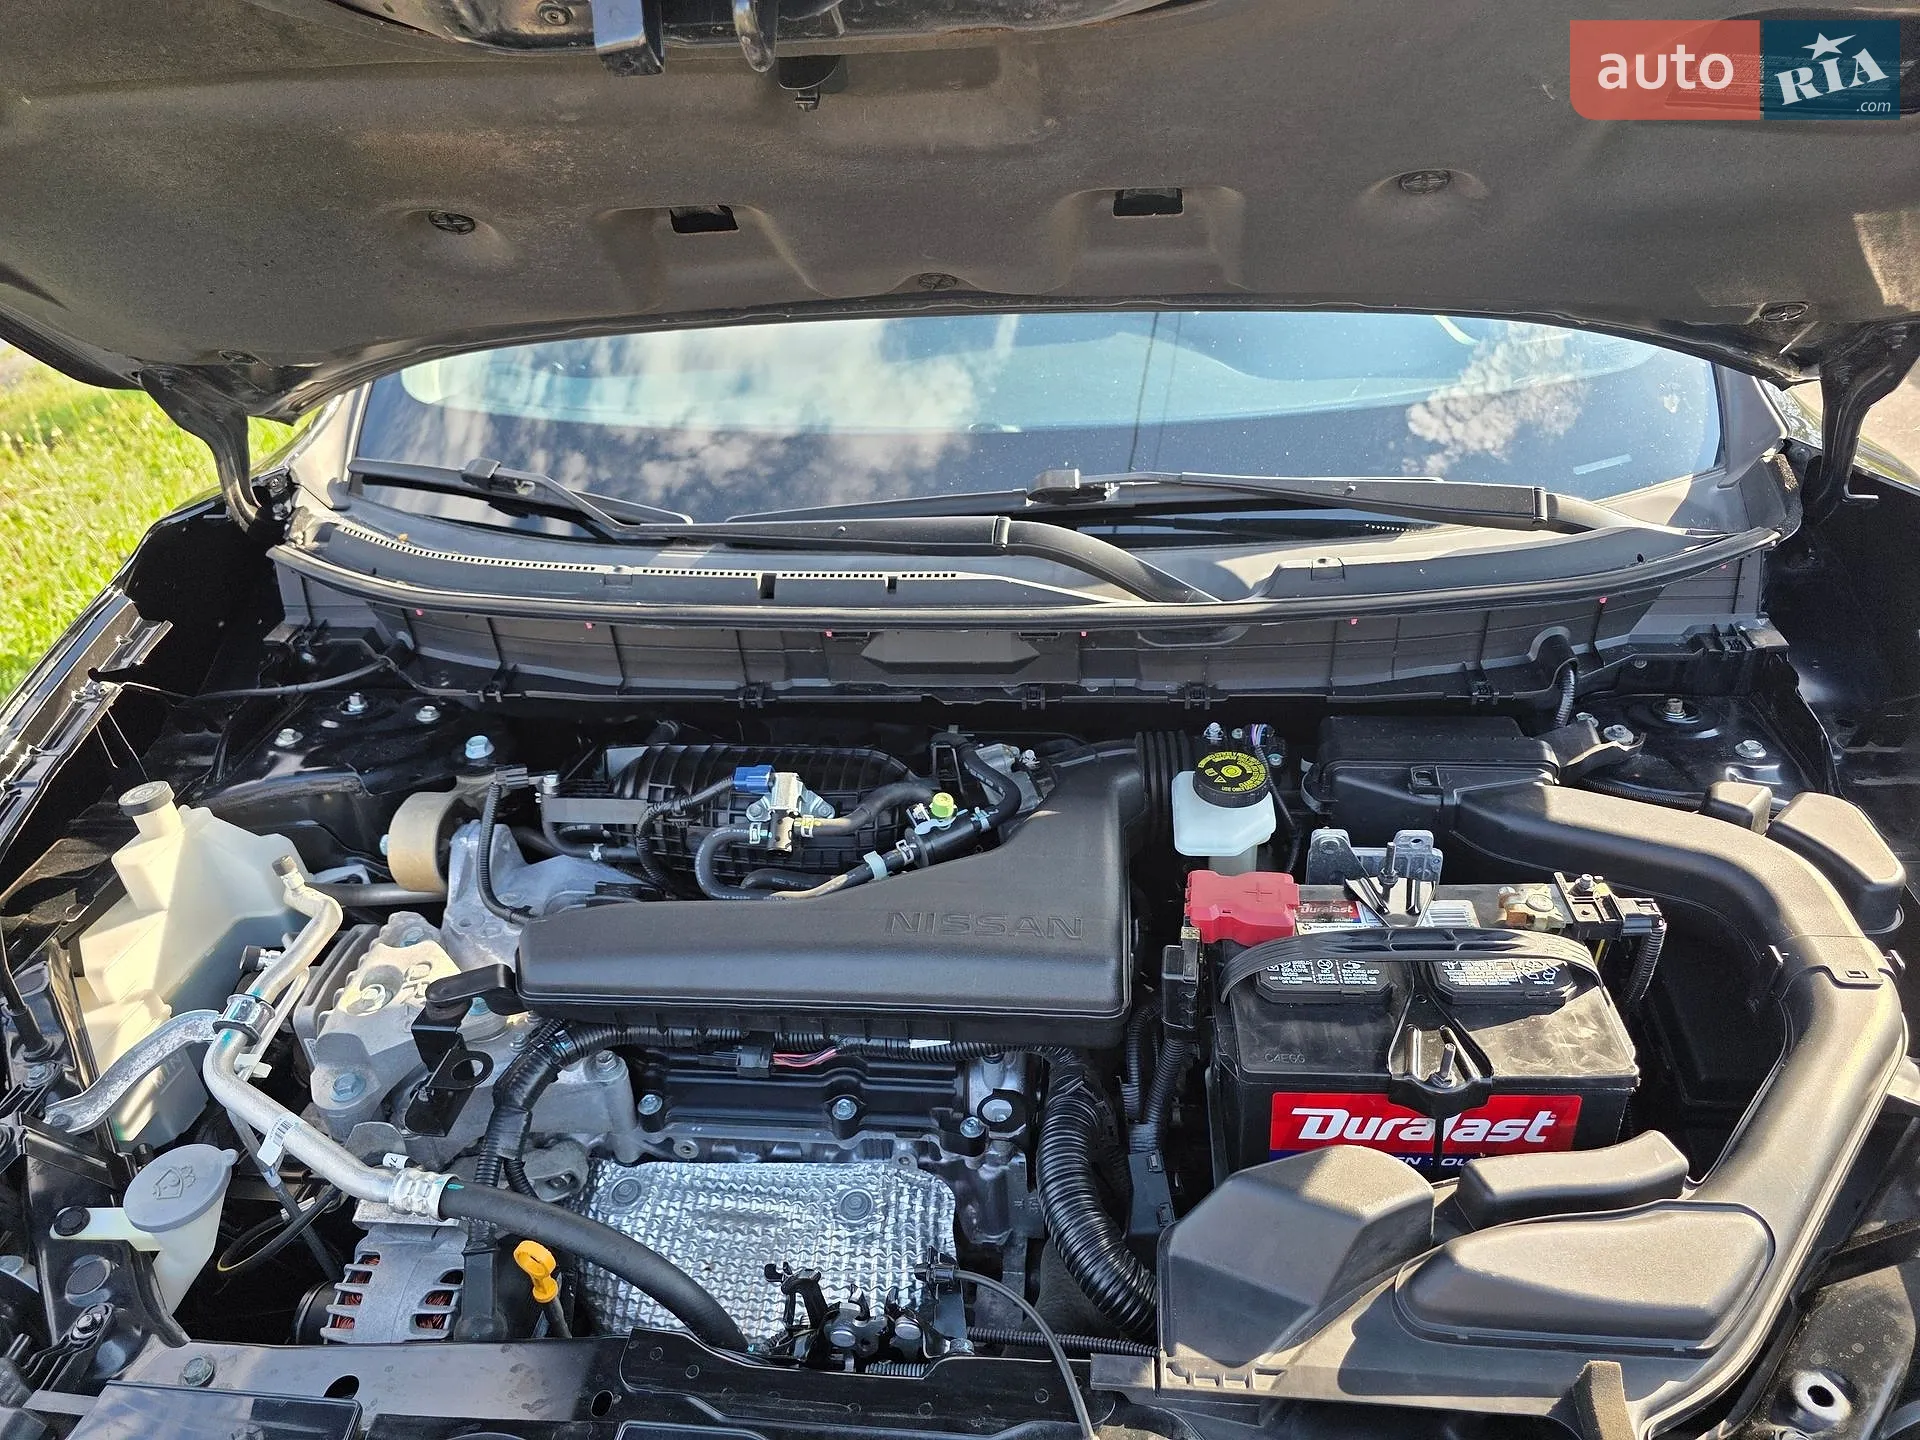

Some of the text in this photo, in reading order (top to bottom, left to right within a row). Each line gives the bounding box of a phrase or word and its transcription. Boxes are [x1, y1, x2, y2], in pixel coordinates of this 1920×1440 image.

[1298, 903, 1354, 914] Duralast
[884, 911, 1084, 940] NISSAN
[1291, 1107, 1556, 1143] Duralast
